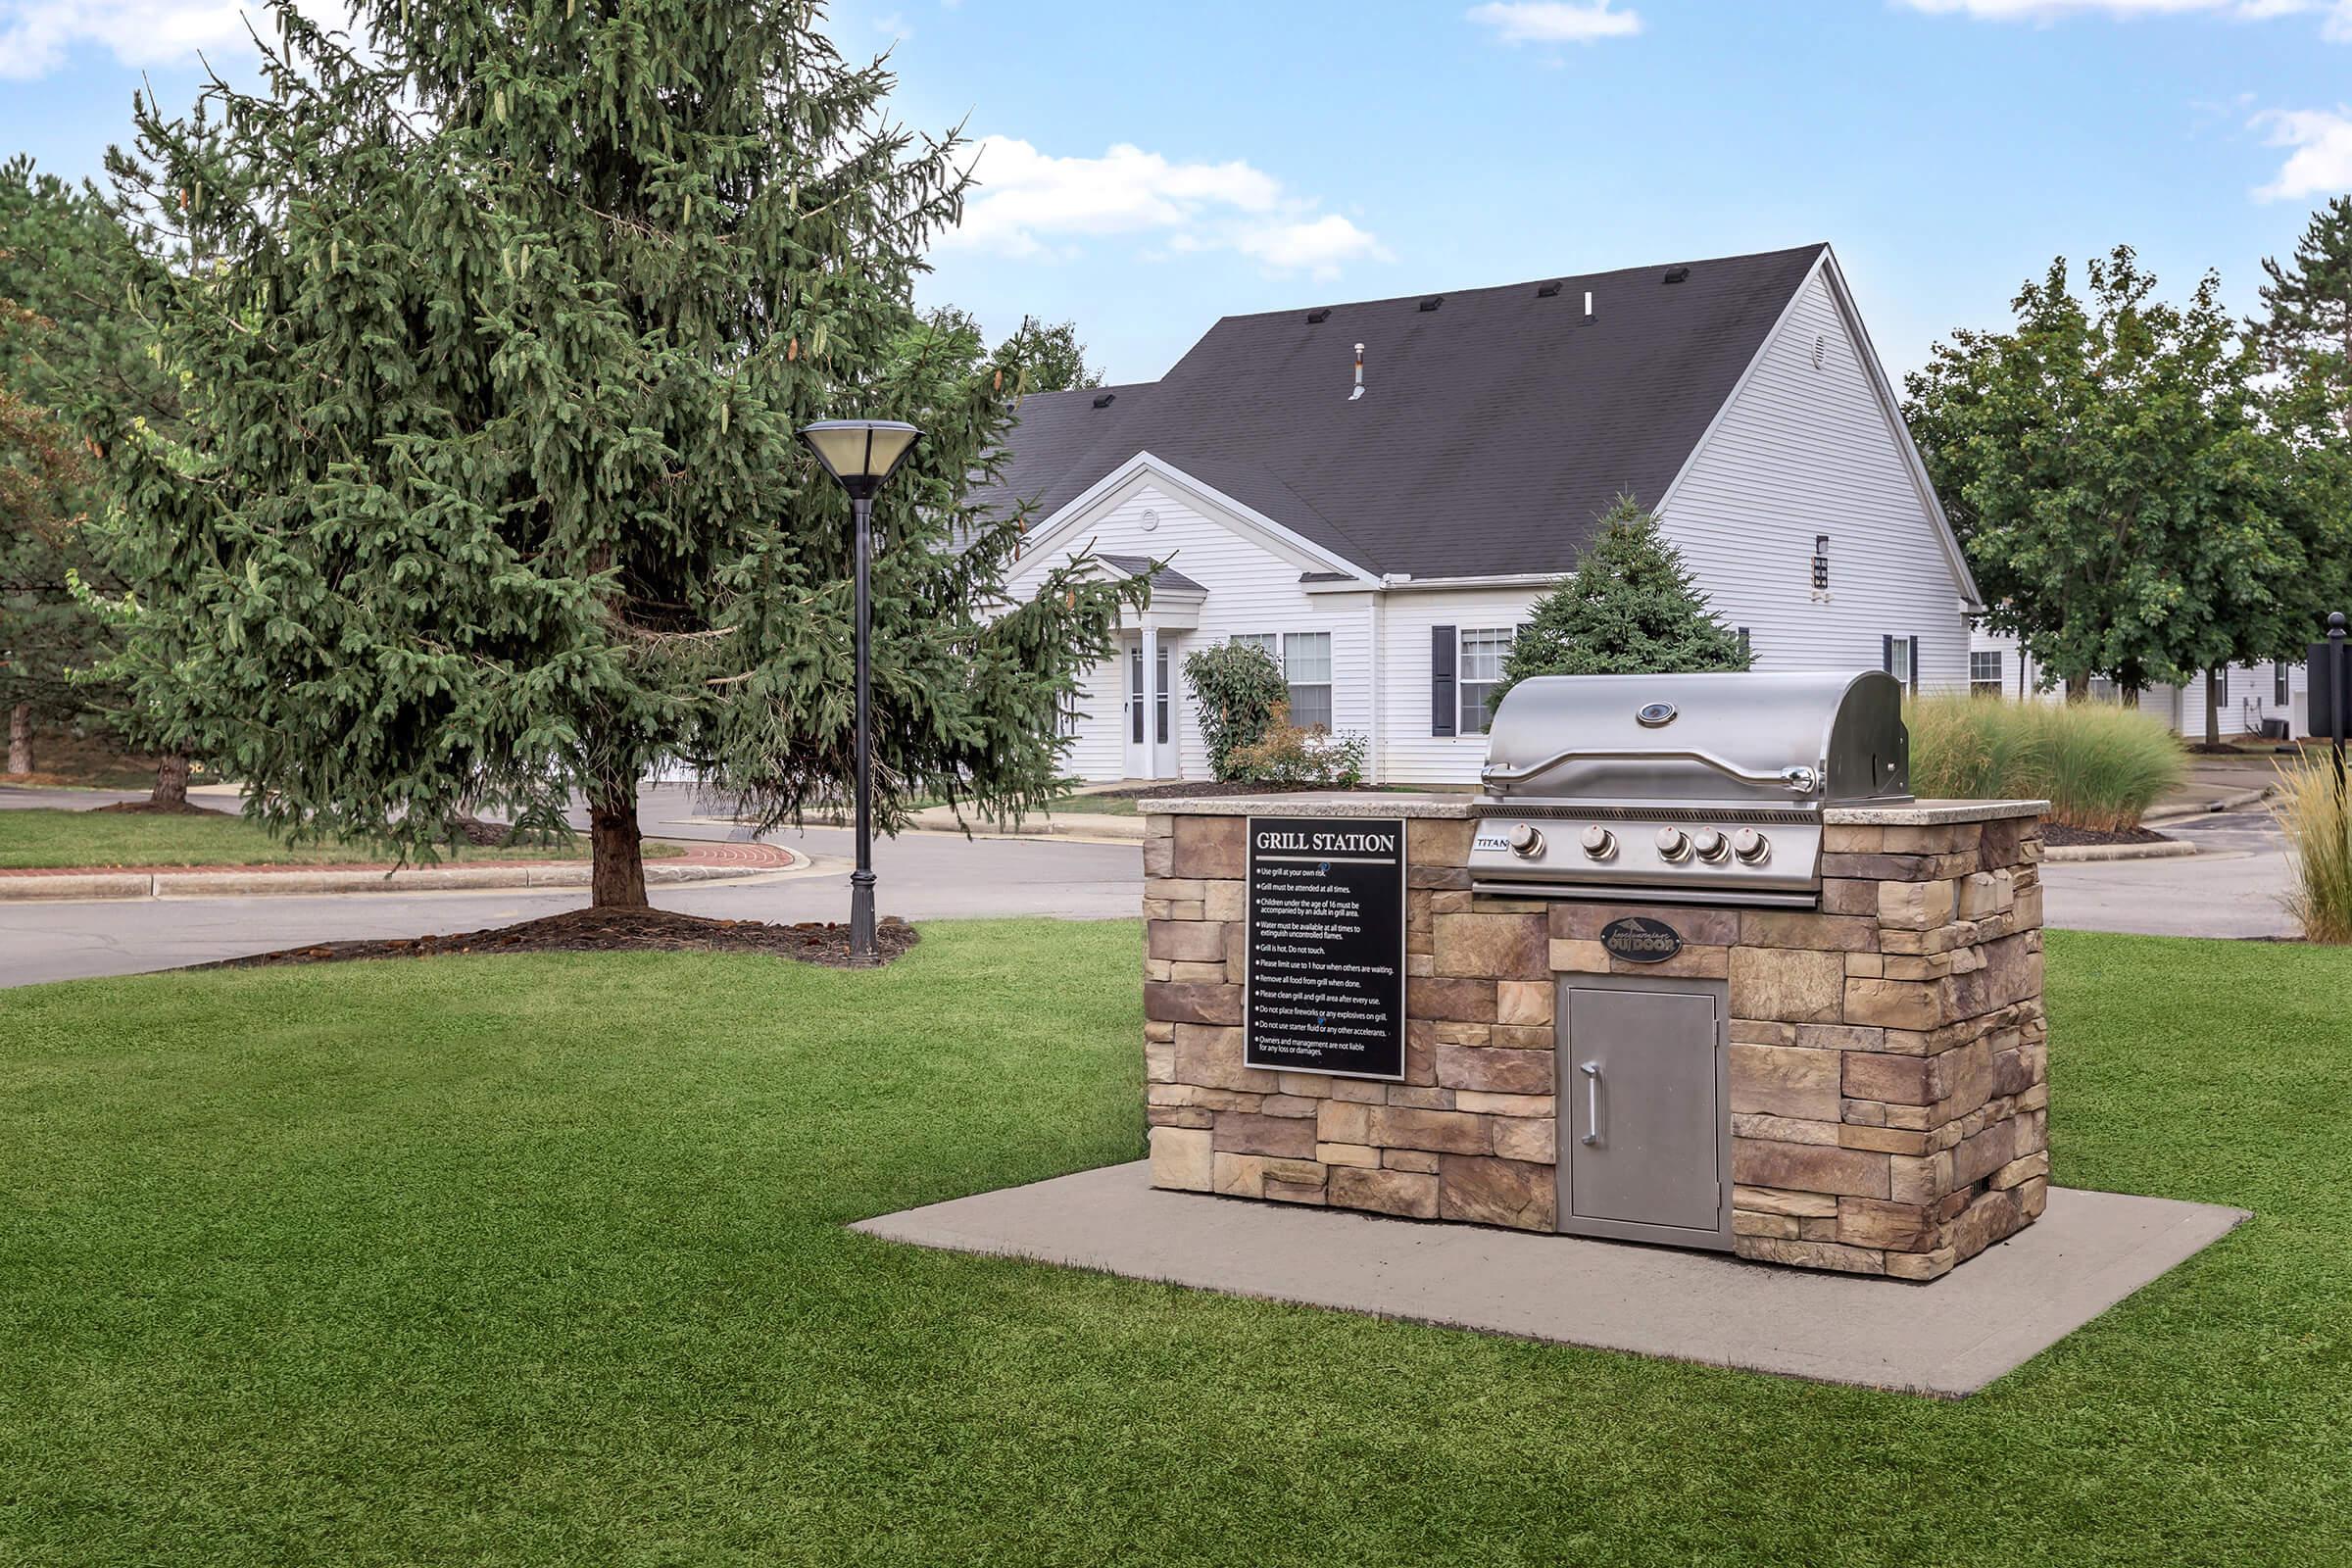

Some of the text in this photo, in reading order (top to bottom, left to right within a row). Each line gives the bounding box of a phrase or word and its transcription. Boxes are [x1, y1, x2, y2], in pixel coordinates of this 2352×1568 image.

[1256, 832, 1396, 852] GRILL STATION
[1272, 868, 1283, 877] grill
[1334, 909, 1345, 918] grill
[1261, 930, 1288, 938] extinguish
[1343, 964, 1361, 972] others
[1260, 975, 1282, 983] Remove
[1290, 976, 1303, 984] food
[1317, 978, 1328, 987] grill
[1293, 992, 1303, 1001] grill
[1315, 993, 1325, 1002] grill
[1339, 995, 1352, 1003] after
[1279, 1007, 1294, 1015] place
[1294, 1007, 1318, 1016] fireworks
[1326, 1011, 1336, 1019] any
[1337, 1011, 1365, 1020] explosives
[1307, 1023, 1319, 1032] fluid
[1327, 1027, 1337, 1035] any
[1292, 1039, 1328, 1048] management
[1349, 1043, 1364, 1051] liable
